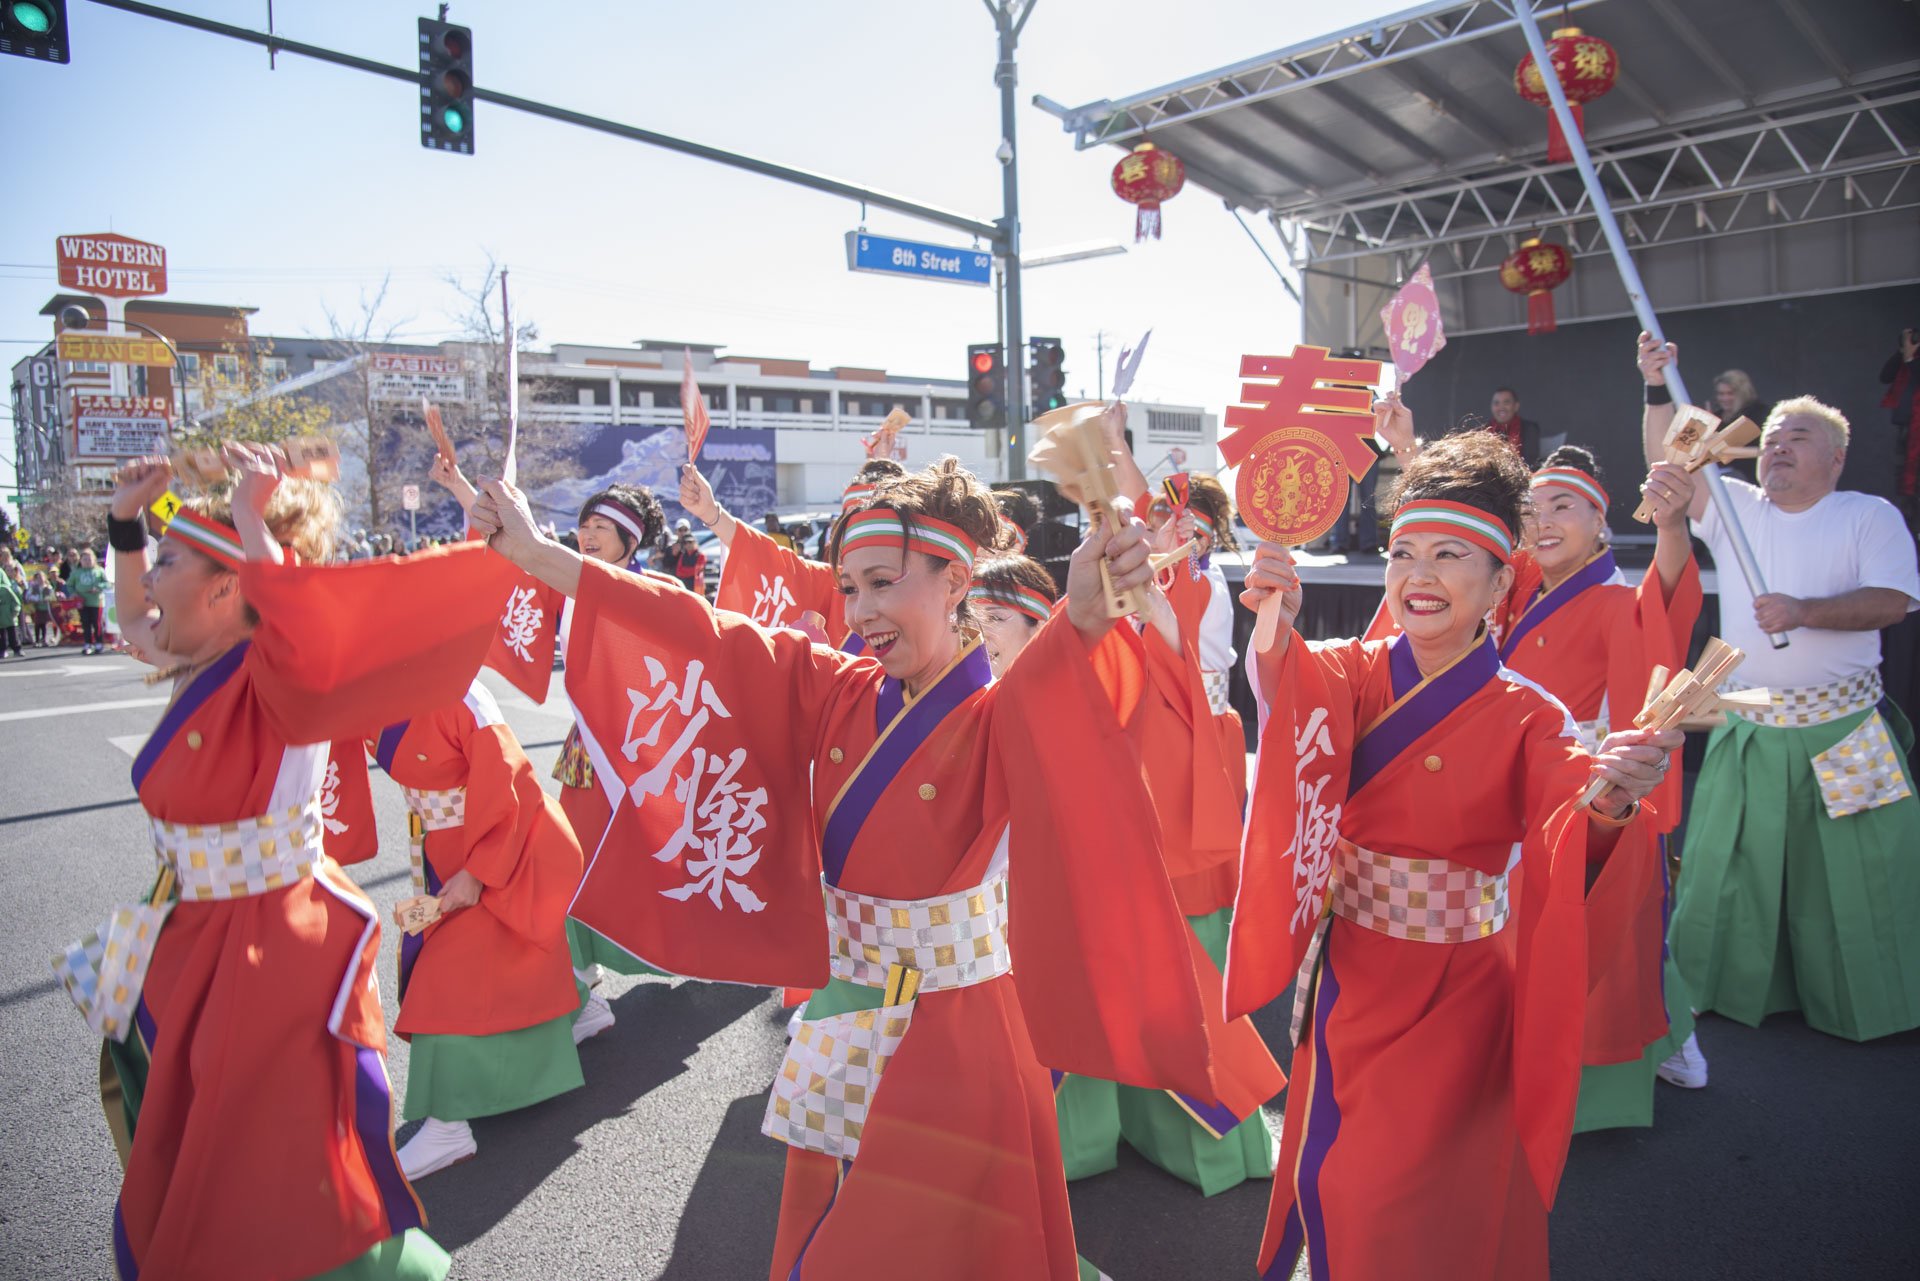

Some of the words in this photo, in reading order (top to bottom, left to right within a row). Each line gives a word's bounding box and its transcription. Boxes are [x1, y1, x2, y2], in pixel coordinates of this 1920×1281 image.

[60, 237, 163, 267] WESTERN
[860, 239, 869, 251] S
[892, 247, 917, 268] 8th
[921, 250, 961, 273] Street
[76, 265, 156, 292] HOTEL
[63, 336, 172, 363] BINGO
[375, 358, 459, 373] CASINO
[79, 395, 166, 410] CASINO
[137, 422, 161, 430] EVENT
